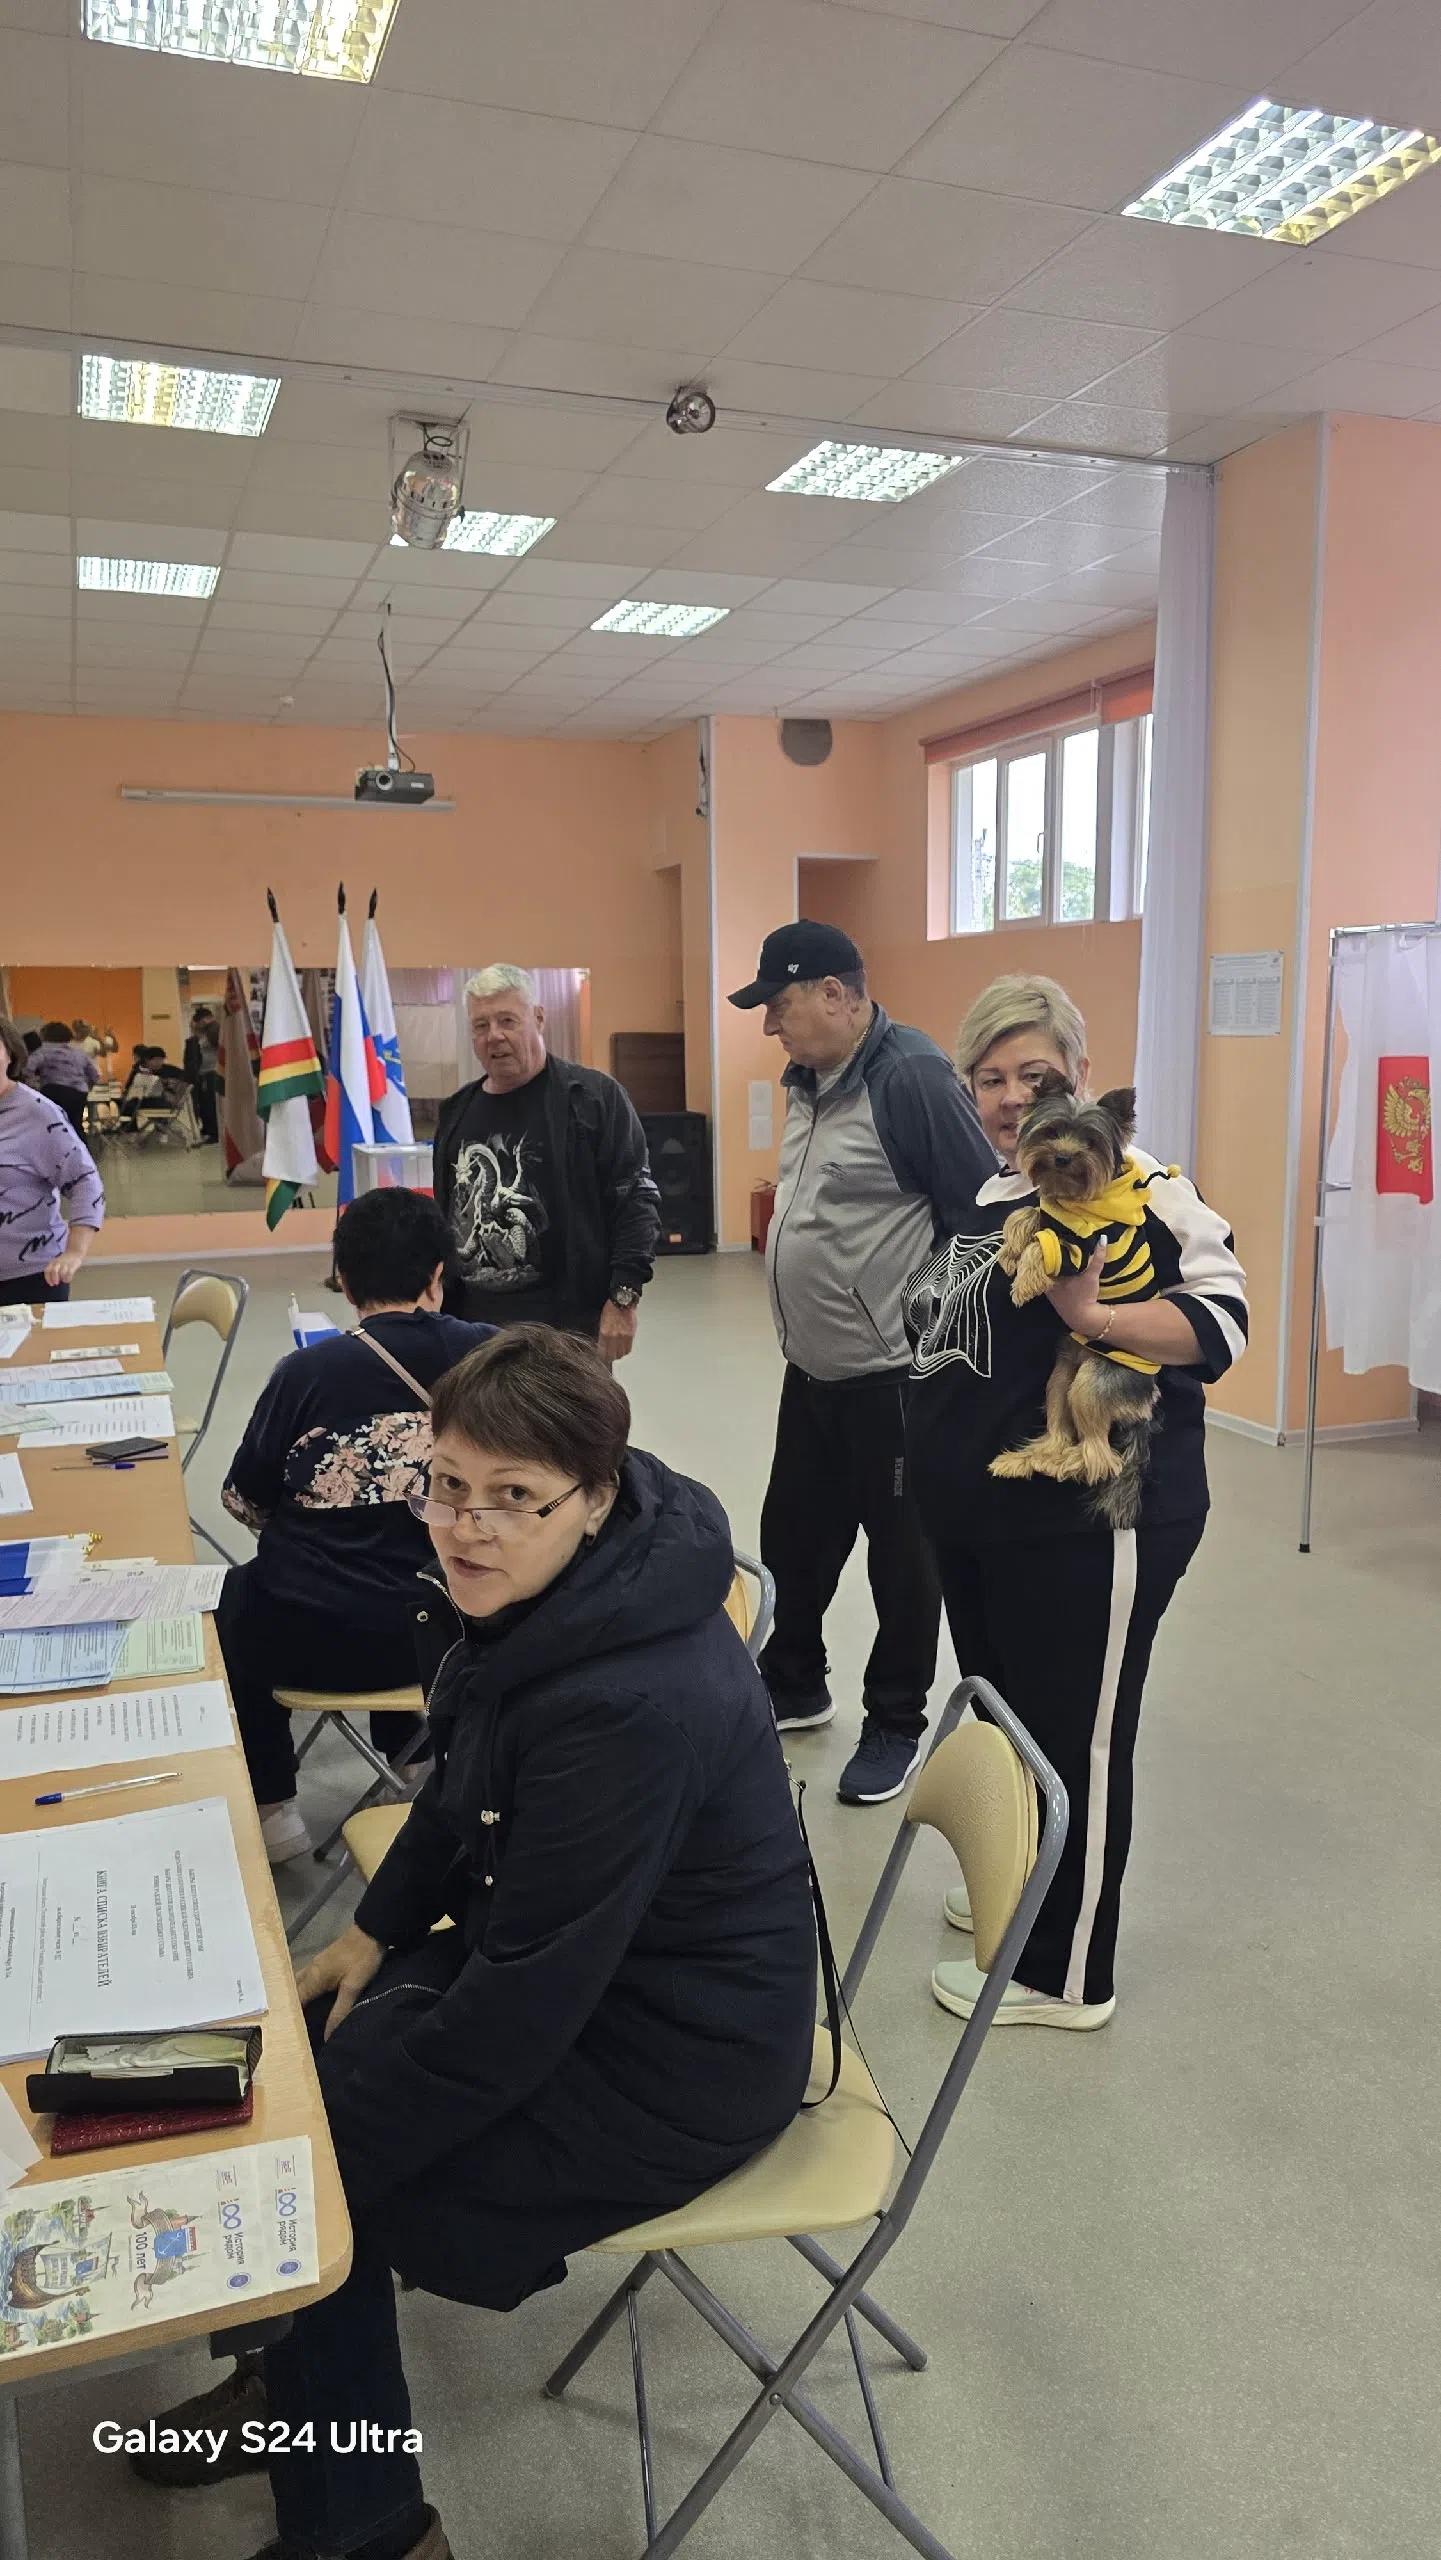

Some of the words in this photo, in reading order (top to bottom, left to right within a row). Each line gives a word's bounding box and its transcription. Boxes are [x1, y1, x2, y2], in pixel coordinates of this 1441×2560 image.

[96, 1895, 108, 1928] СПИСКА
[135, 2231, 148, 2250] 100
[278, 2220, 288, 2246] рядом
[288, 2219, 297, 2253] История
[223, 2234, 234, 2259] рядом
[234, 2232, 245, 2264] История
[136, 2253, 147, 2269] лет
